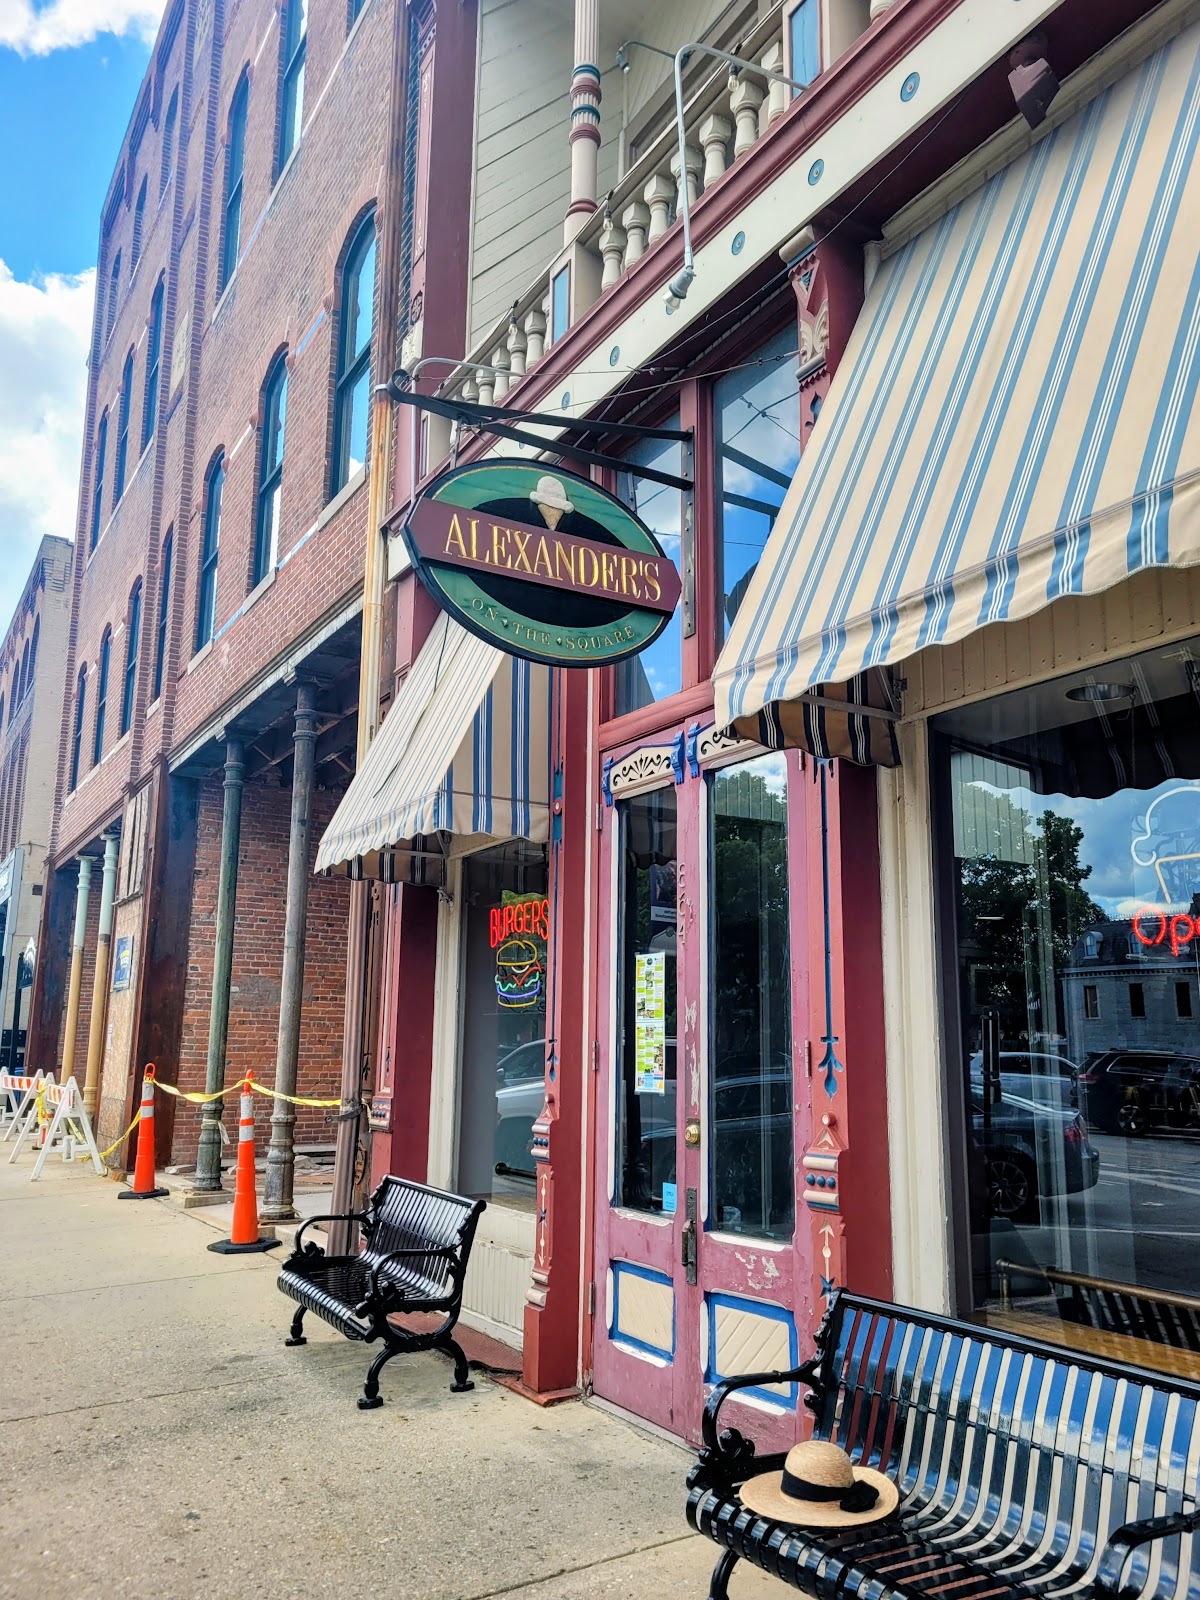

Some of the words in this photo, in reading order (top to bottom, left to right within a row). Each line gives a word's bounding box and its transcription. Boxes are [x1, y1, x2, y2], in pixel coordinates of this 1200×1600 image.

[442, 513, 661, 602] ALEXANDER'S
[472, 597, 499, 622] ON
[513, 622, 551, 645] THE
[565, 624, 635, 653] SQUARE
[489, 899, 549, 948] BURGERS
